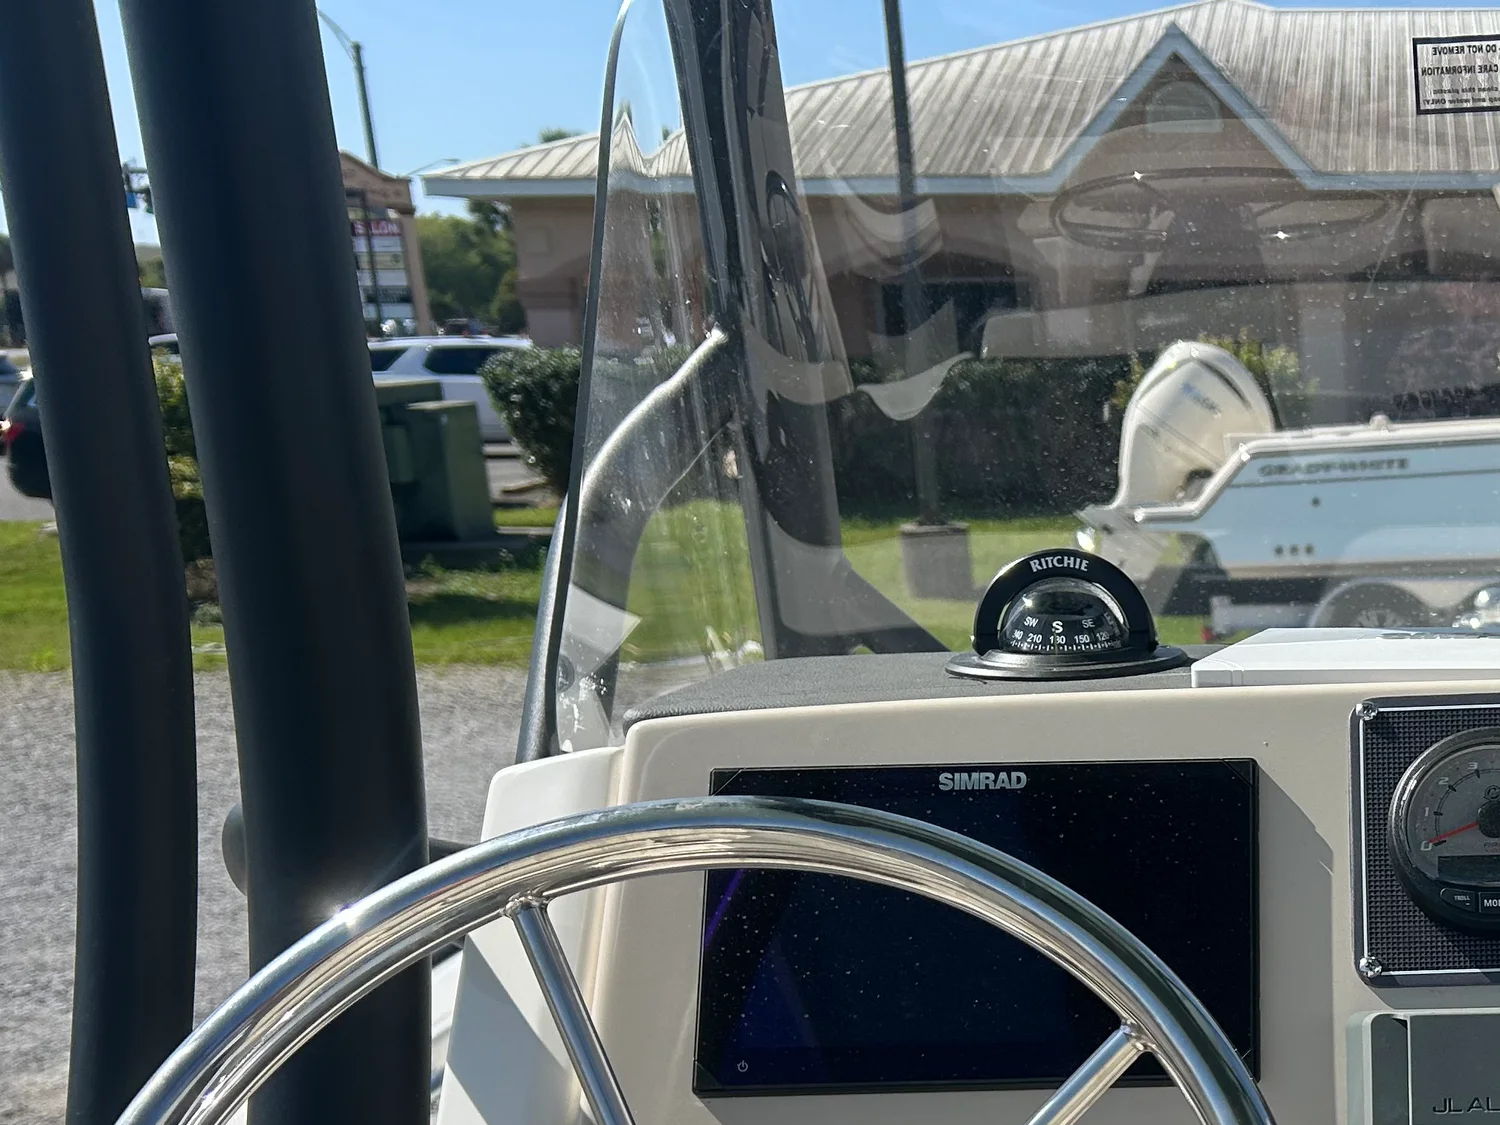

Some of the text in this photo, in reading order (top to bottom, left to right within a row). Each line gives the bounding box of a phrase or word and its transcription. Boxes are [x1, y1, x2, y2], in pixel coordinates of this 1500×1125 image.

[354, 223, 400, 236] SLON
[1029, 556, 1090, 573] RITCHIE
[1023, 616, 1040, 628] SW
[1052, 620, 1064, 633] S
[1082, 619, 1095, 628] SE
[1026, 633, 1042, 644] 210
[1074, 635, 1090, 644] 150
[1467, 762, 1478, 770] 3
[938, 771, 1027, 791] SIMRAD
[1438, 777, 1449, 785] 2
[1432, 1097, 1463, 1115] JL
